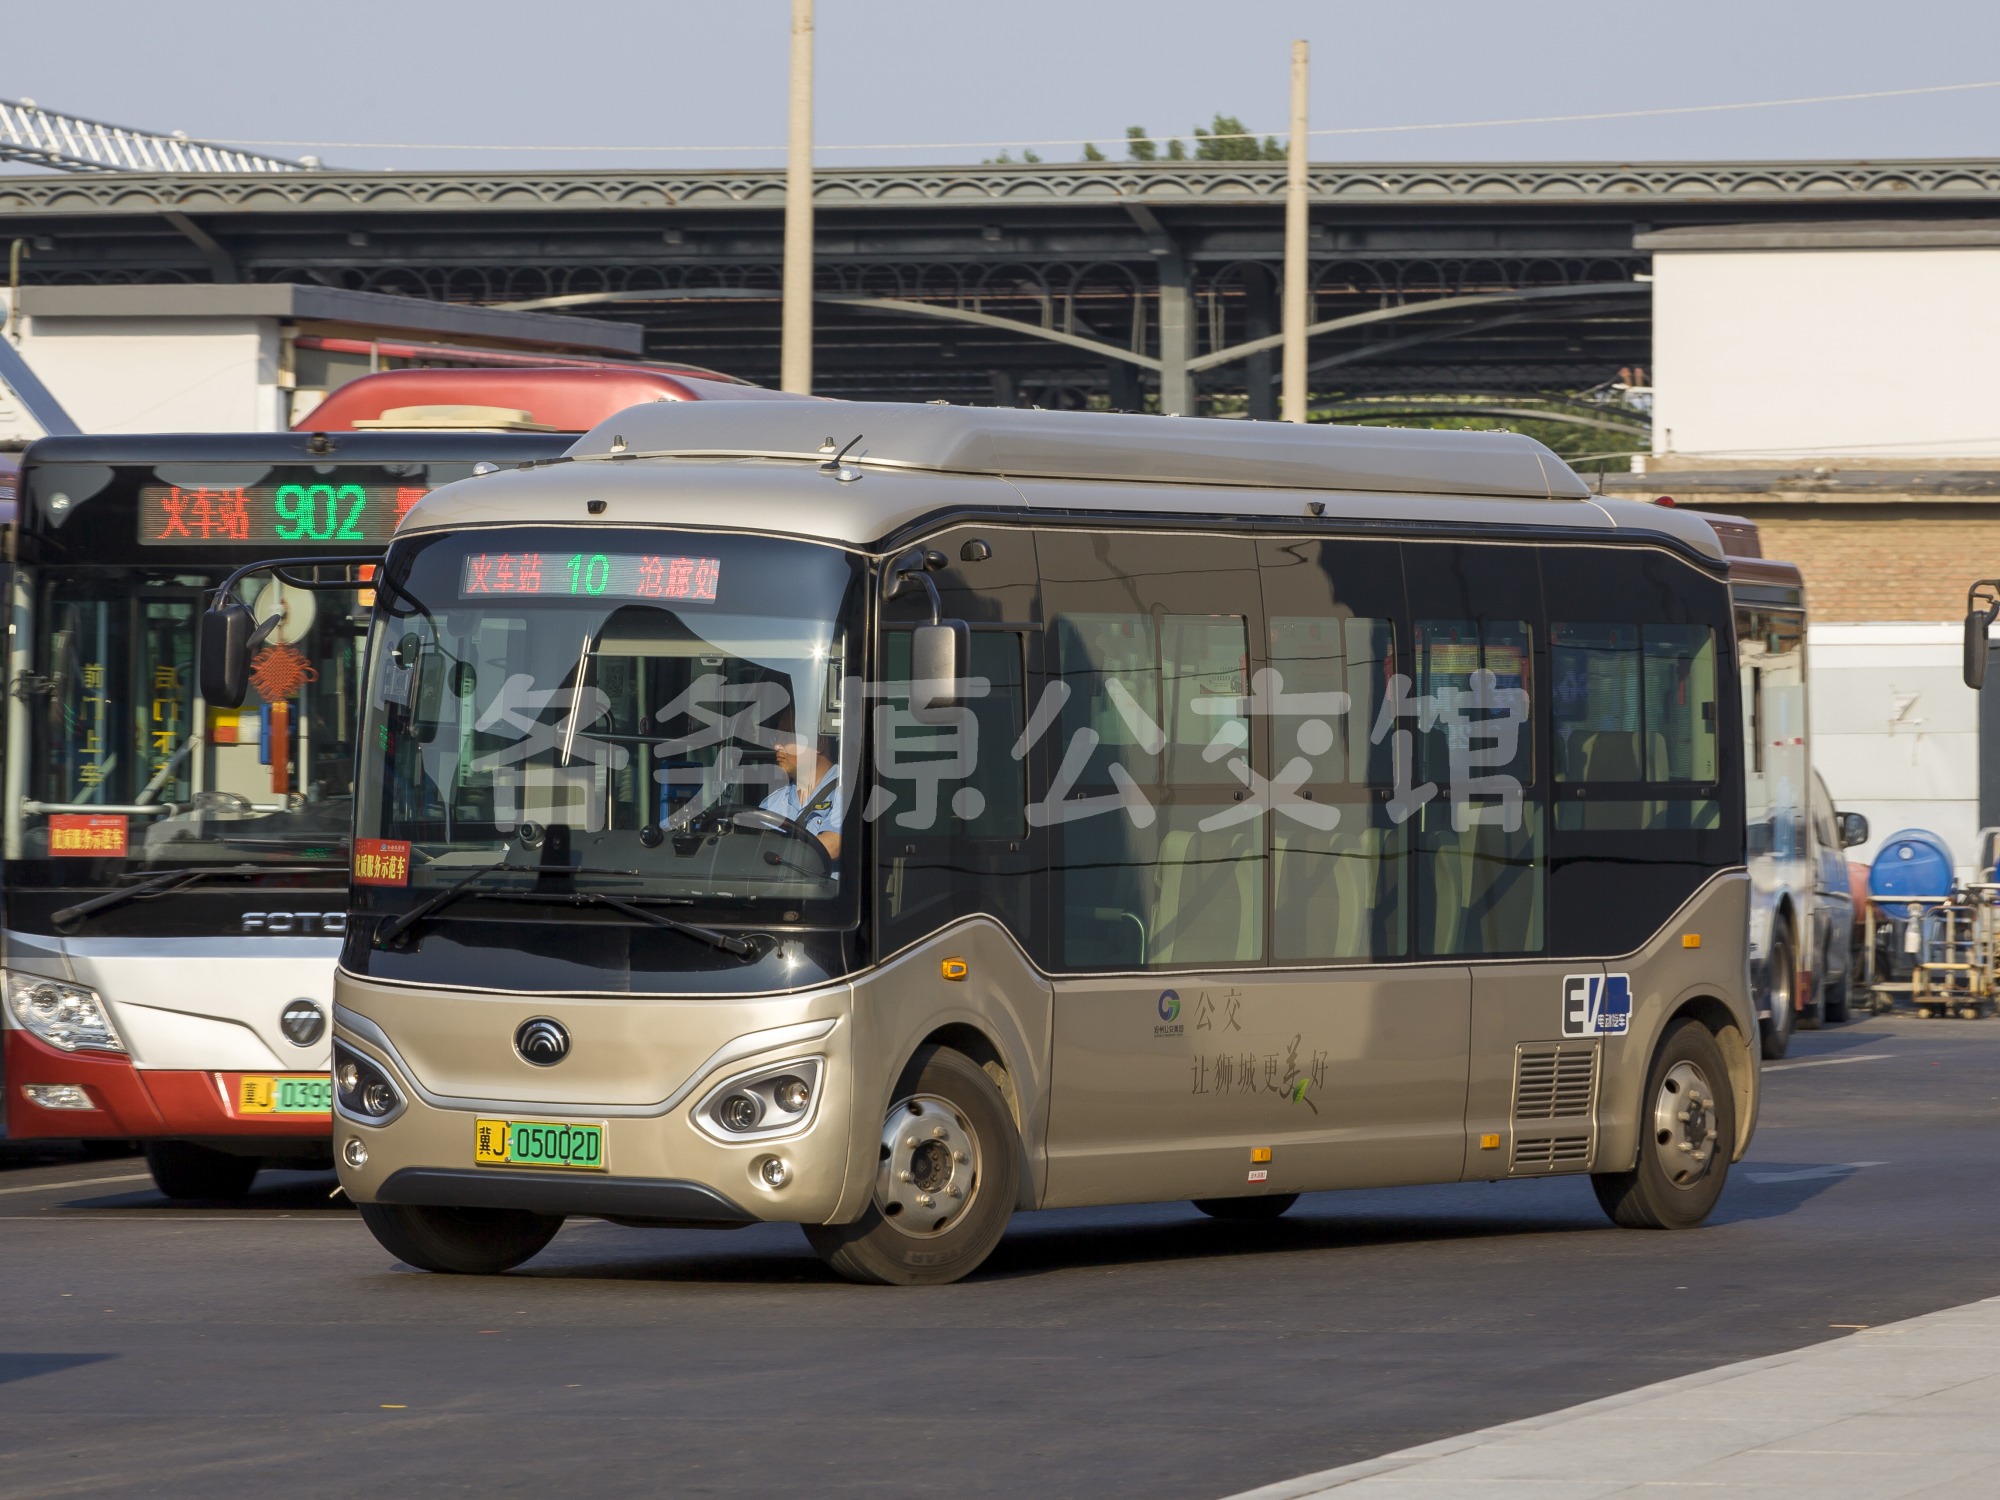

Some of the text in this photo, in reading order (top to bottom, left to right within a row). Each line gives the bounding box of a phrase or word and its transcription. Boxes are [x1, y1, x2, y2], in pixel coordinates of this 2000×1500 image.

[157, 486, 250, 539] 火车站
[275, 484, 366, 539] 902
[466, 553, 543, 593] 火车站
[567, 554, 609, 596] 10
[1193, 987, 1242, 1033] 公交
[1191, 1033, 1329, 1116] 让狮城更美好
